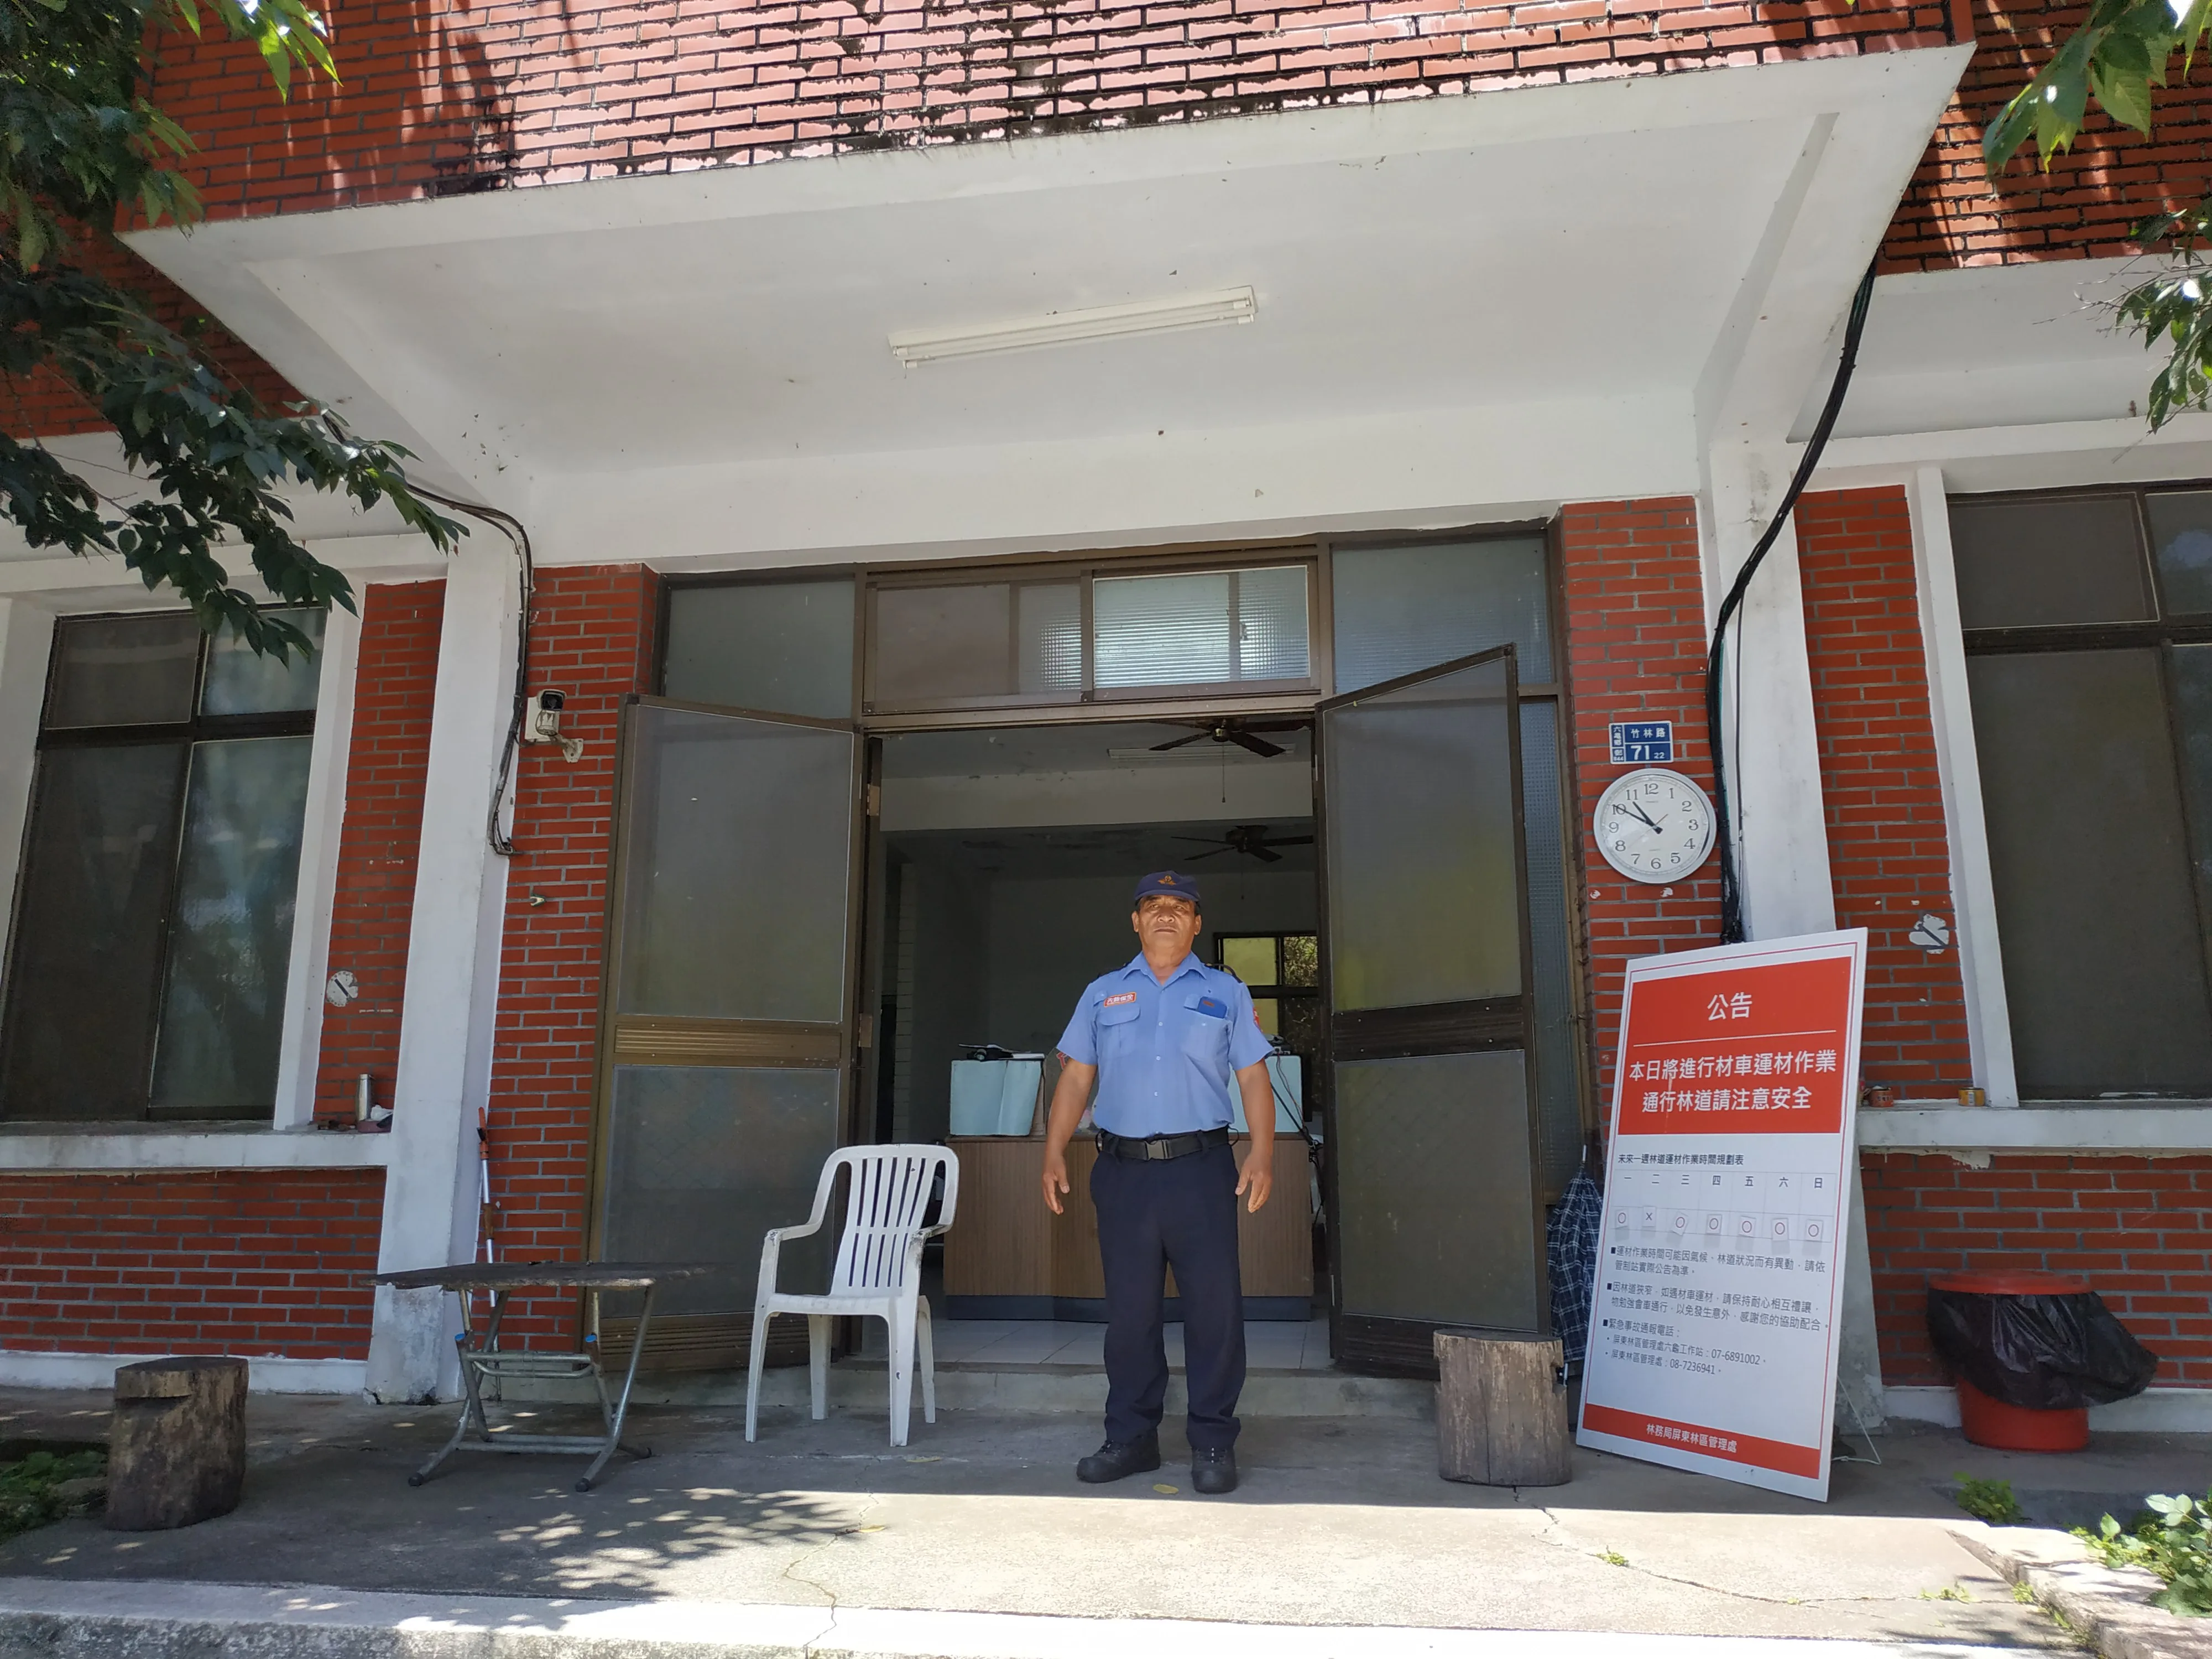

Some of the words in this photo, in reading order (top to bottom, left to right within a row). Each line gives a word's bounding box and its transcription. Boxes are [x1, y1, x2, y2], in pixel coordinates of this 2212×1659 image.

[1630, 727, 1666, 738] 竹林路
[1630, 745, 1650, 760] 71
[1626, 789, 1639, 801] 11
[1644, 783, 1659, 795] 12
[1669, 787, 1674, 799] 1
[1612, 804, 1626, 815] 10
[1682, 801, 1692, 812] 2
[1609, 822, 1619, 833] 9
[1688, 819, 1699, 831] 3
[1615, 840, 1626, 852] 8
[1684, 838, 1695, 849] 4
[1631, 854, 1641, 865] 7
[1650, 858, 1661, 870] 6
[1670, 853, 1681, 864] 5
[1707, 992, 1753, 1021] 公告
[1629, 1048, 1837, 1082] 本日將進行材車運材作業
[1642, 1086, 1812, 1113] 通行林道請注意安全
[1651, 1173, 1660, 1184] 二
[1681, 1174, 1689, 1185] 三
[1712, 1175, 1721, 1186] 四
[1744, 1176, 1754, 1187] 五
[1778, 1176, 1789, 1187] 六
[1814, 1177, 1823, 1188] 日
[1646, 1423, 1737, 1453] 林務局屏東林區管理處
